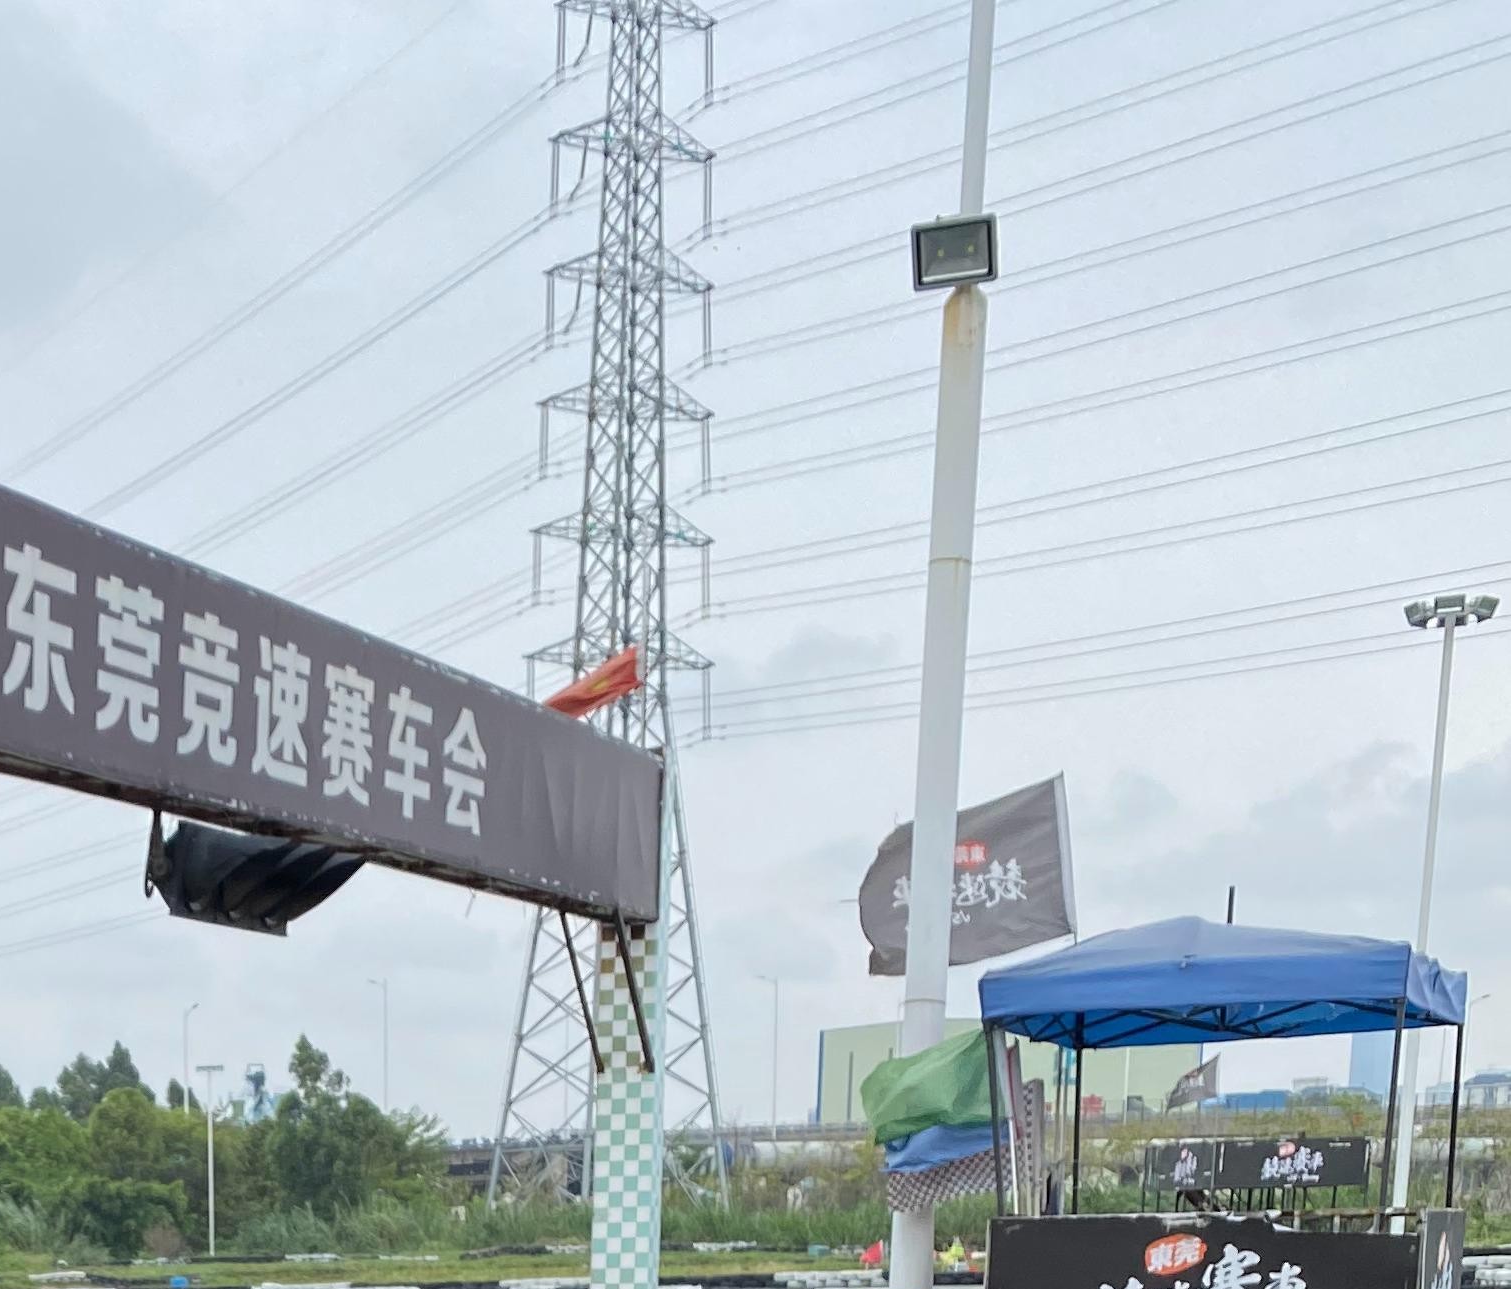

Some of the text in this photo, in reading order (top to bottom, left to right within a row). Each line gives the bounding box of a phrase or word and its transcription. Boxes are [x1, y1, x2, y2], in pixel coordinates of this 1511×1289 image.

[2, 542, 487, 836] 东莞竞速赛车会
